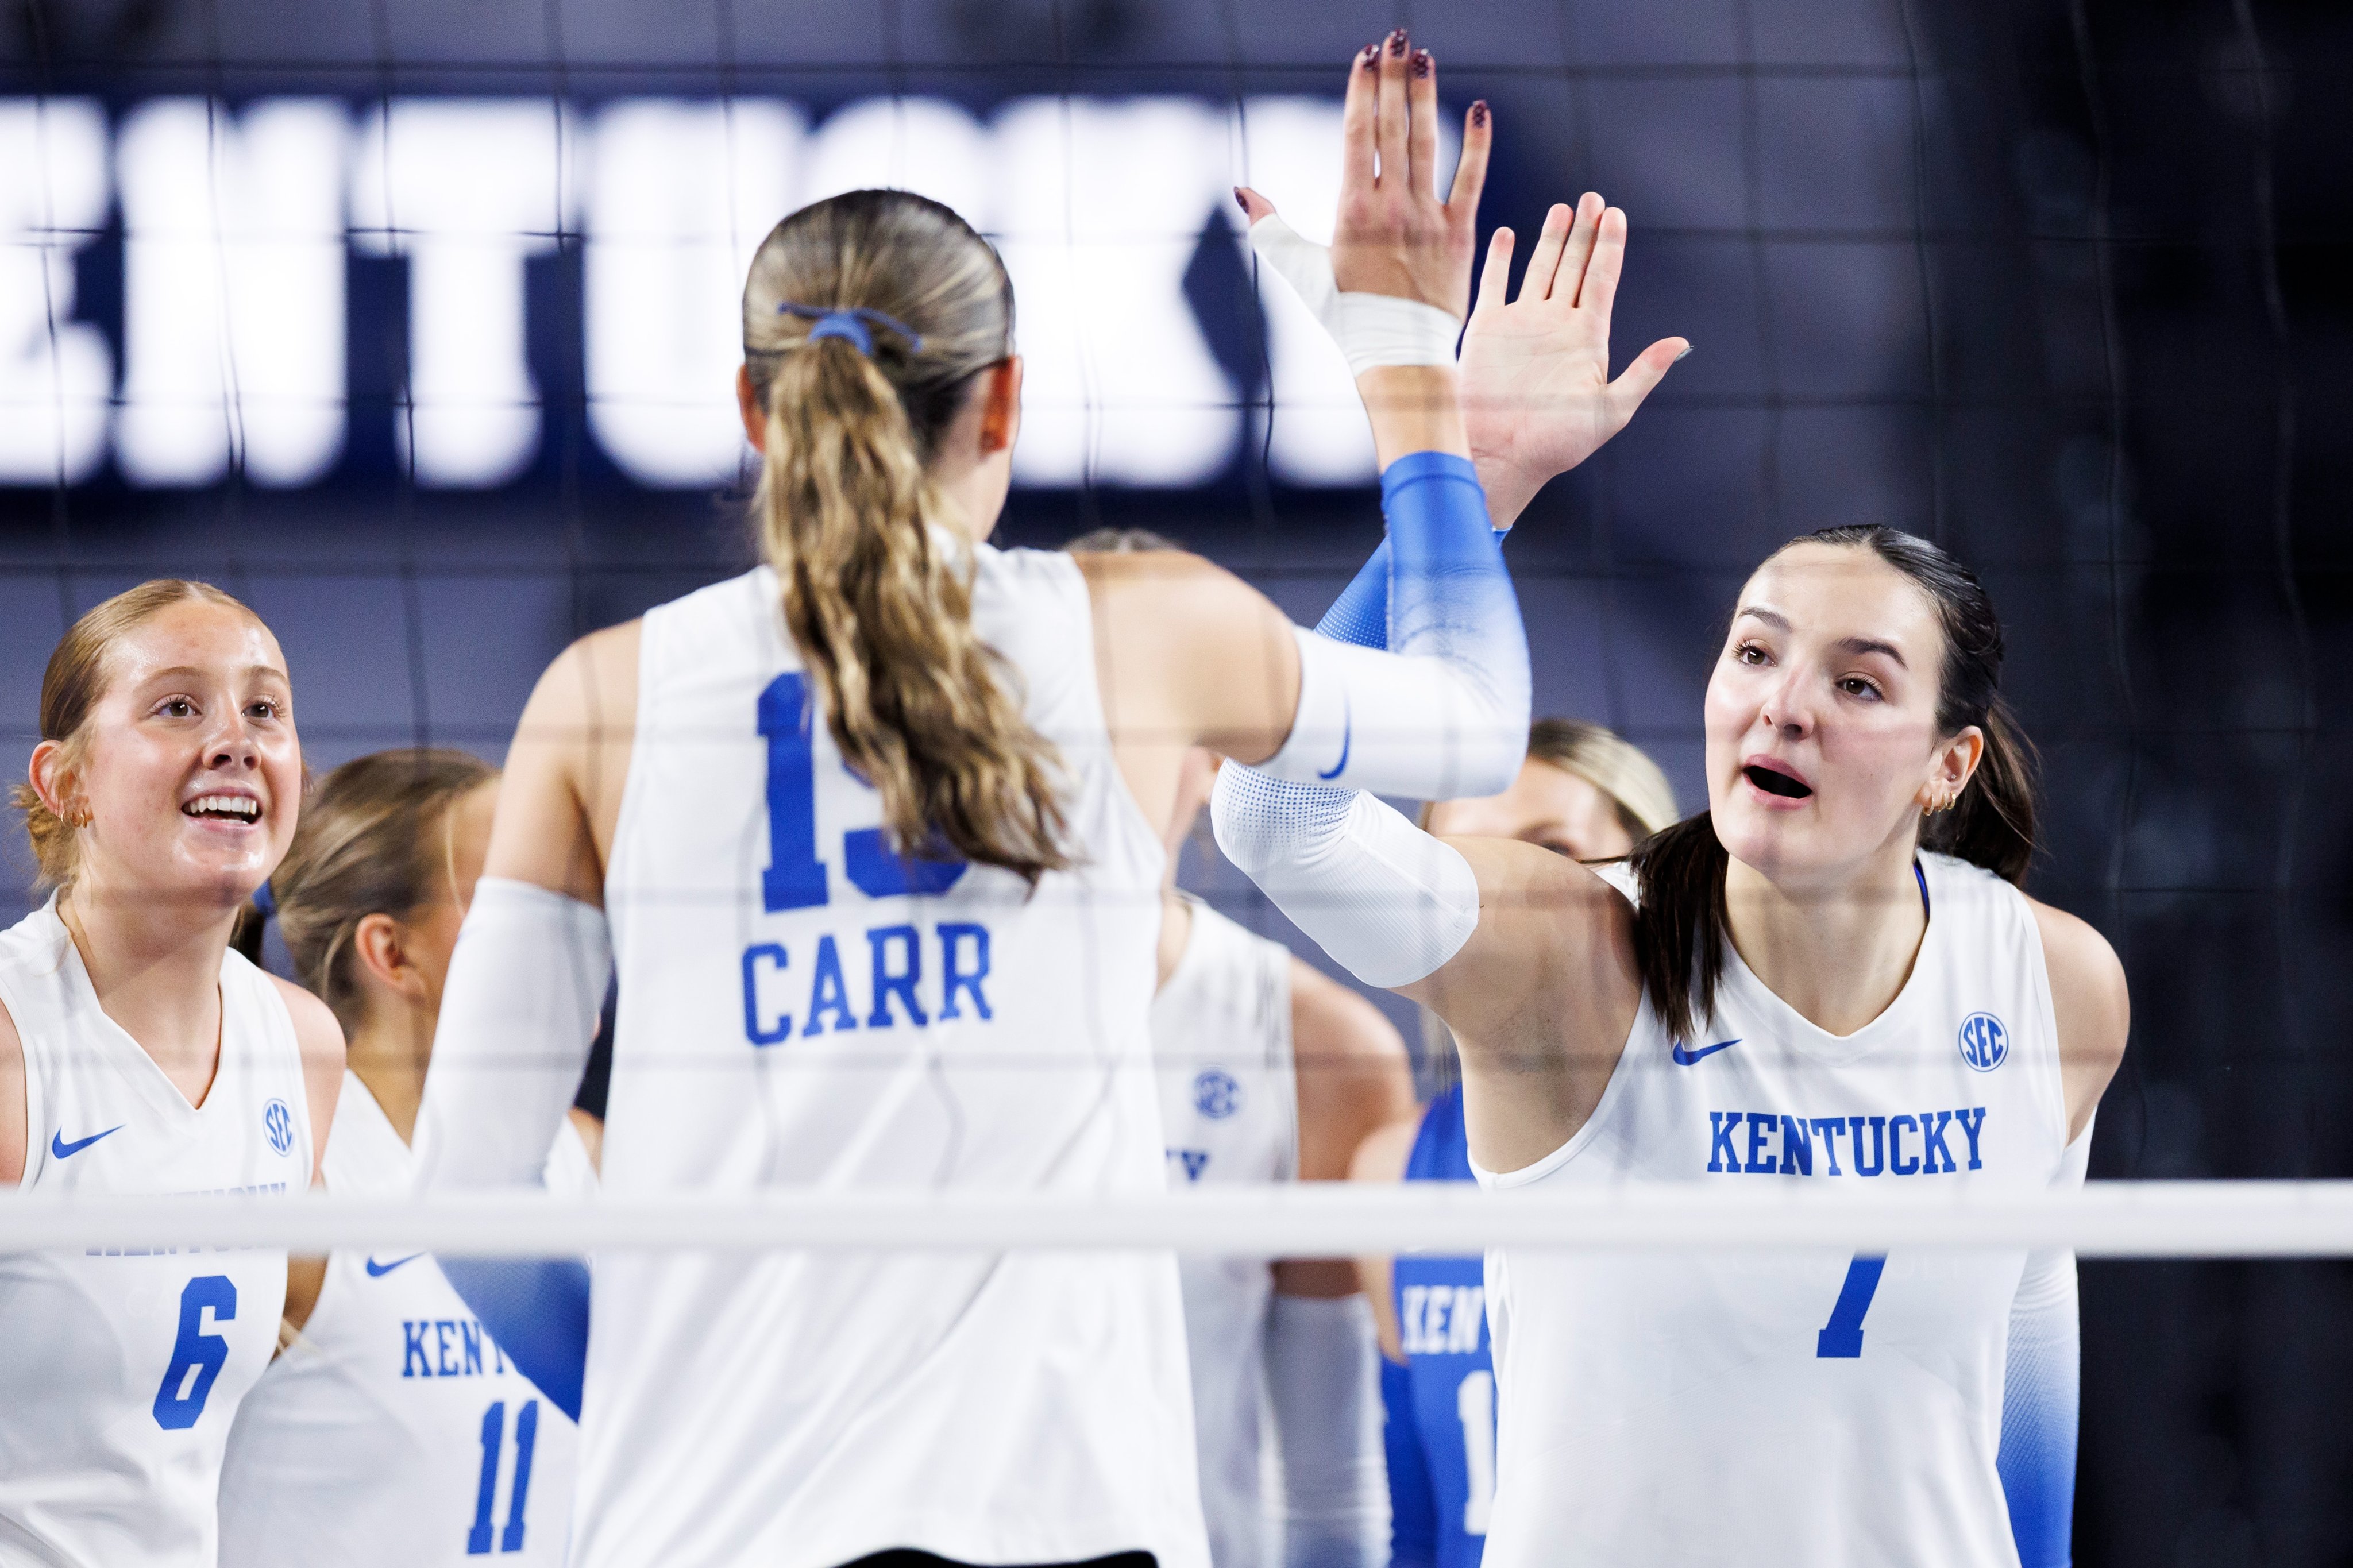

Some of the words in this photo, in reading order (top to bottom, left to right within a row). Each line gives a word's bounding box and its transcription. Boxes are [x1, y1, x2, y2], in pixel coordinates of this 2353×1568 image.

[742, 921, 992, 1046] CARR
[1963, 1017, 2004, 1068] SEC
[265, 1103, 292, 1152] SEC
[1707, 1106, 1986, 1177] KENTUCKY
[152, 1275, 237, 1430] 6
[464, 1400, 539, 1554] 11
